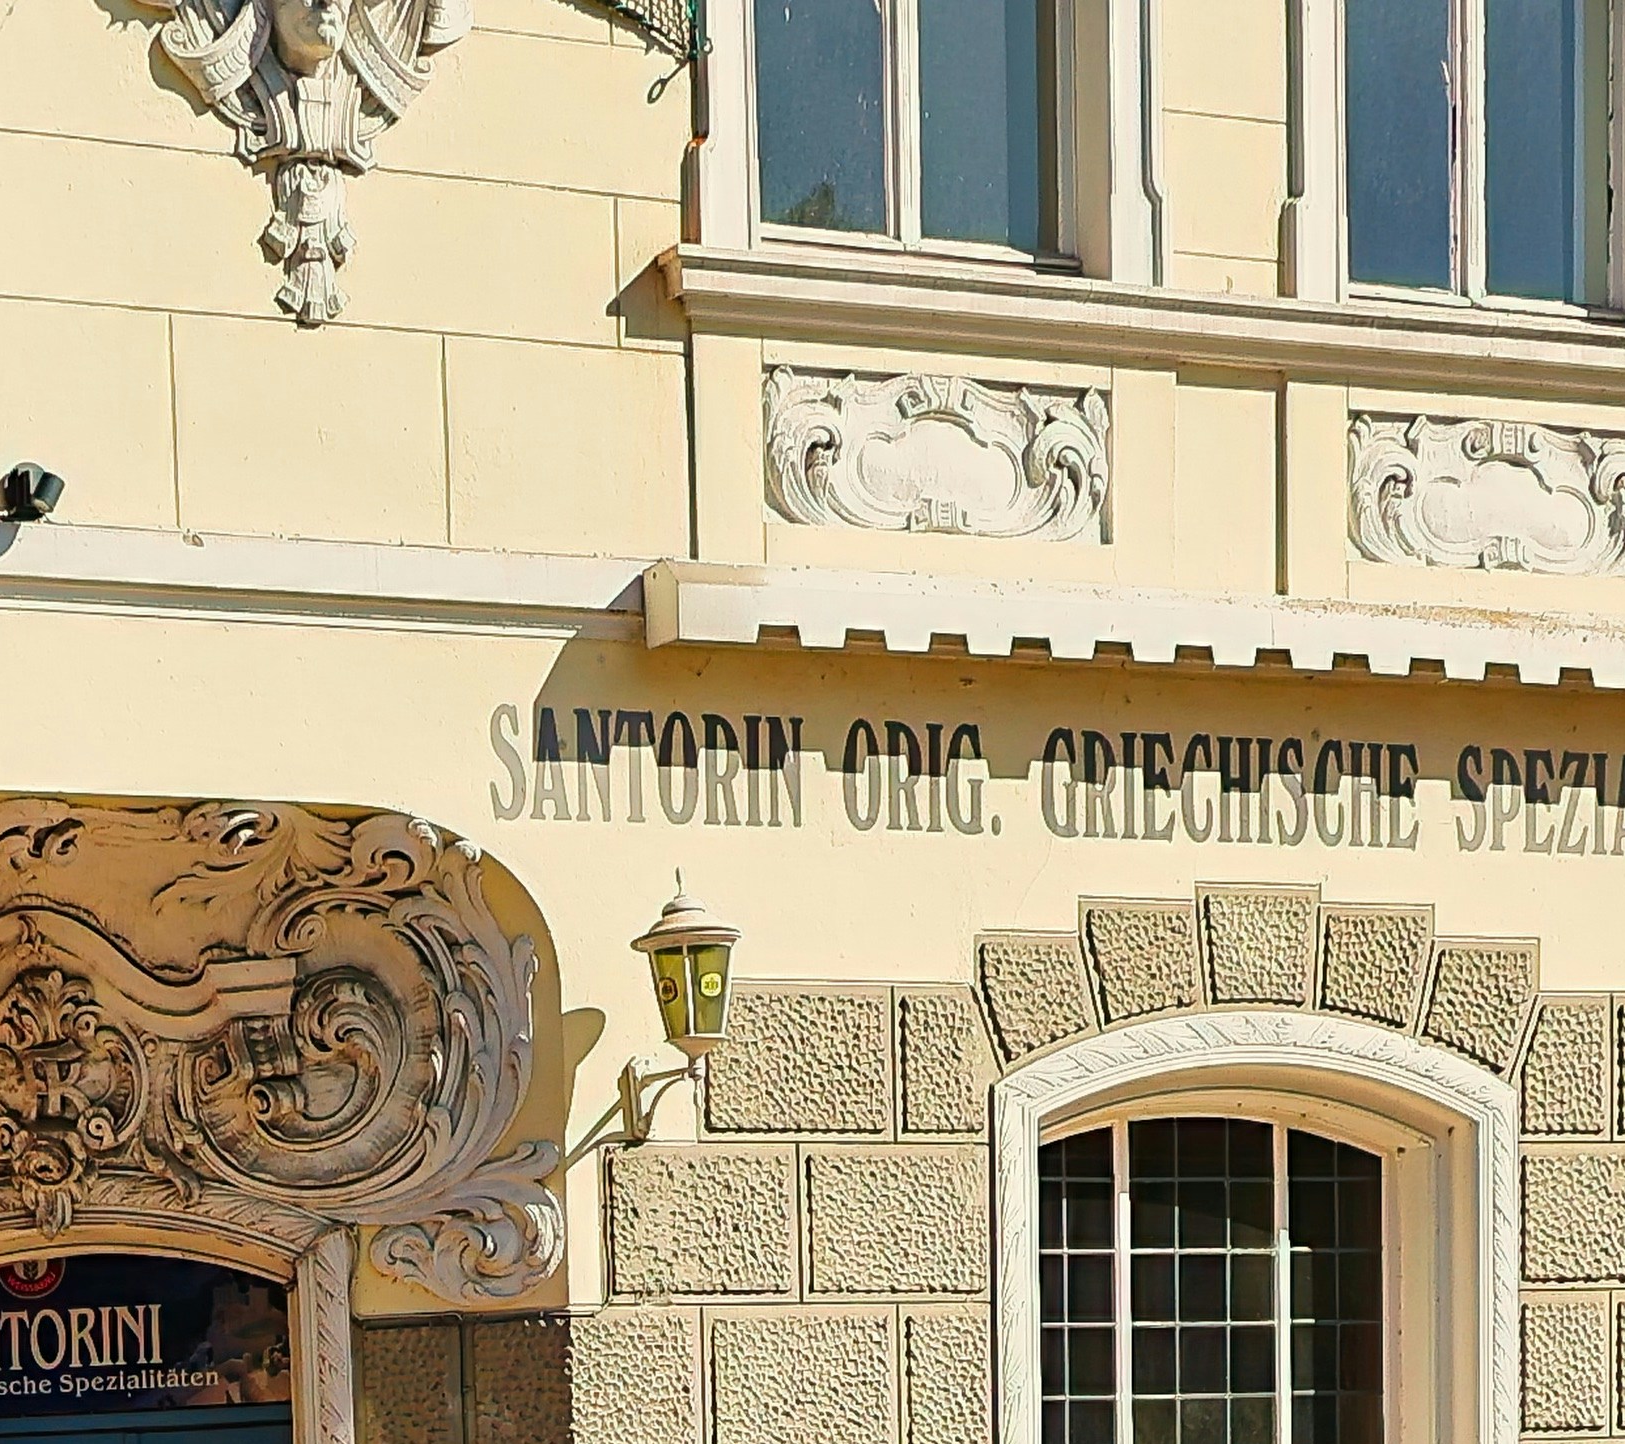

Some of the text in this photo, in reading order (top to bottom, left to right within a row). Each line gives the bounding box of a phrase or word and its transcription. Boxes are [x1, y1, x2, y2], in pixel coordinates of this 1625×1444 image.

[489, 703, 804, 828] SANTORIN
[842, 718, 1002, 837] ORIG.
[1040, 727, 1420, 851] GRIECHISCHE
[59, 1367, 220, 1396] Spezialitäten
